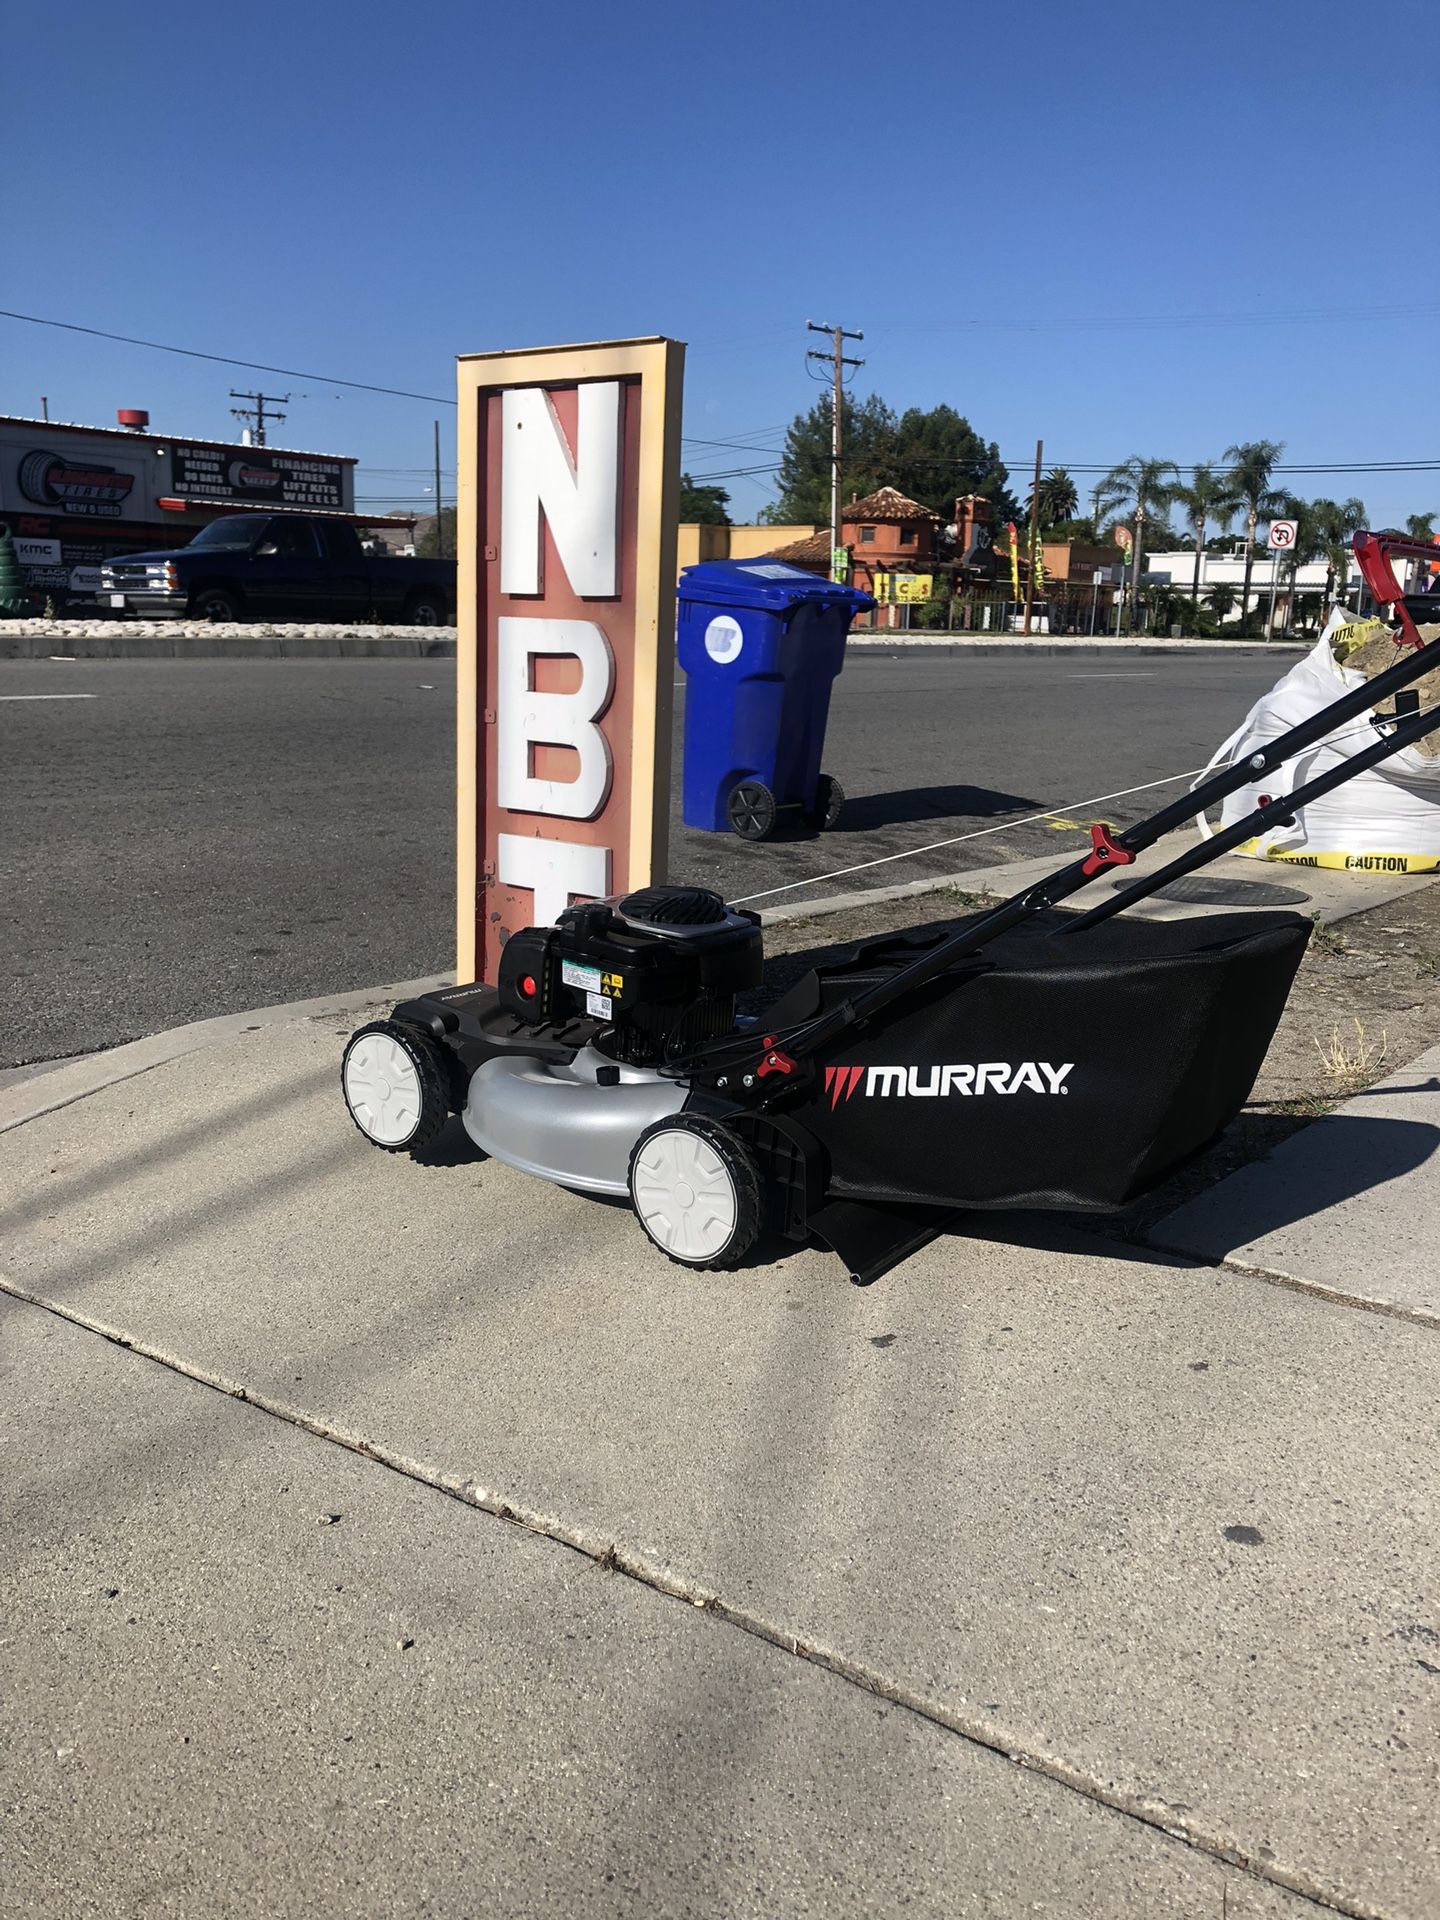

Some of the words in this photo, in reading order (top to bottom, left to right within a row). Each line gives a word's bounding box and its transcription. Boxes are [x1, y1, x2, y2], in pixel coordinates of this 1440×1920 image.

[176, 448, 190, 457] NO
[184, 460, 219, 471] NEEDED
[272, 458, 340, 474] FINANCING
[184, 472, 198, 481] 90
[199, 473, 223, 484] DAYS
[291, 471, 327, 483] TIRES
[63, 485, 117, 498] TIRES
[175, 482, 189, 492] NO
[190, 484, 233, 495] INTEREST
[283, 482, 308, 492] LIFT
[310, 484, 337, 494] KITS
[283, 492, 339, 505] WHEELS
[66, 502, 88, 513] NEW
[97, 505, 120, 516] USED
[879, 583, 929, 595] TCOS
[1345, 855, 1408, 872] CAUTION
